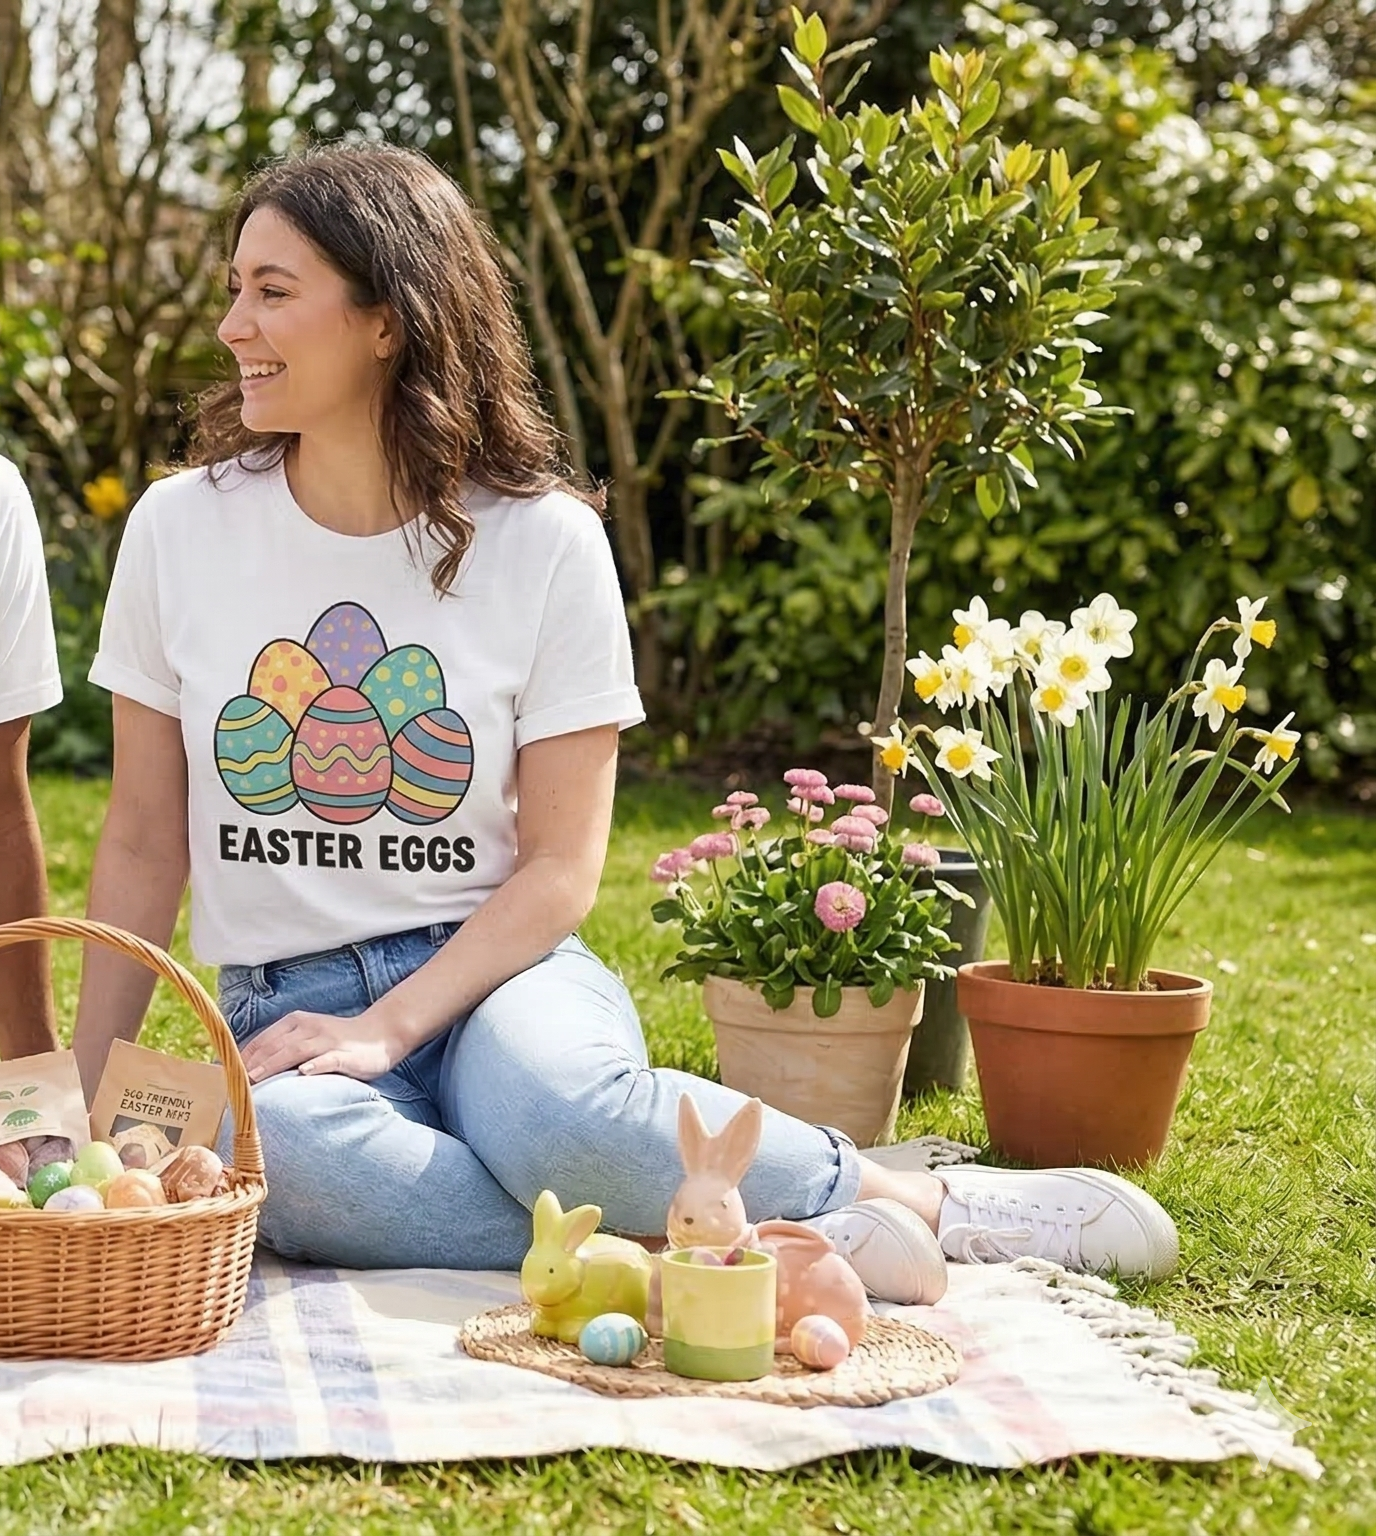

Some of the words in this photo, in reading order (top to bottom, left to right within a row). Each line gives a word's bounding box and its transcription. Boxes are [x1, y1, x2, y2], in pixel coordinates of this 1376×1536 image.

[219, 824, 363, 870] EASTER
[379, 834, 476, 873] EGGS
[120, 1098, 163, 1117] EASTER
